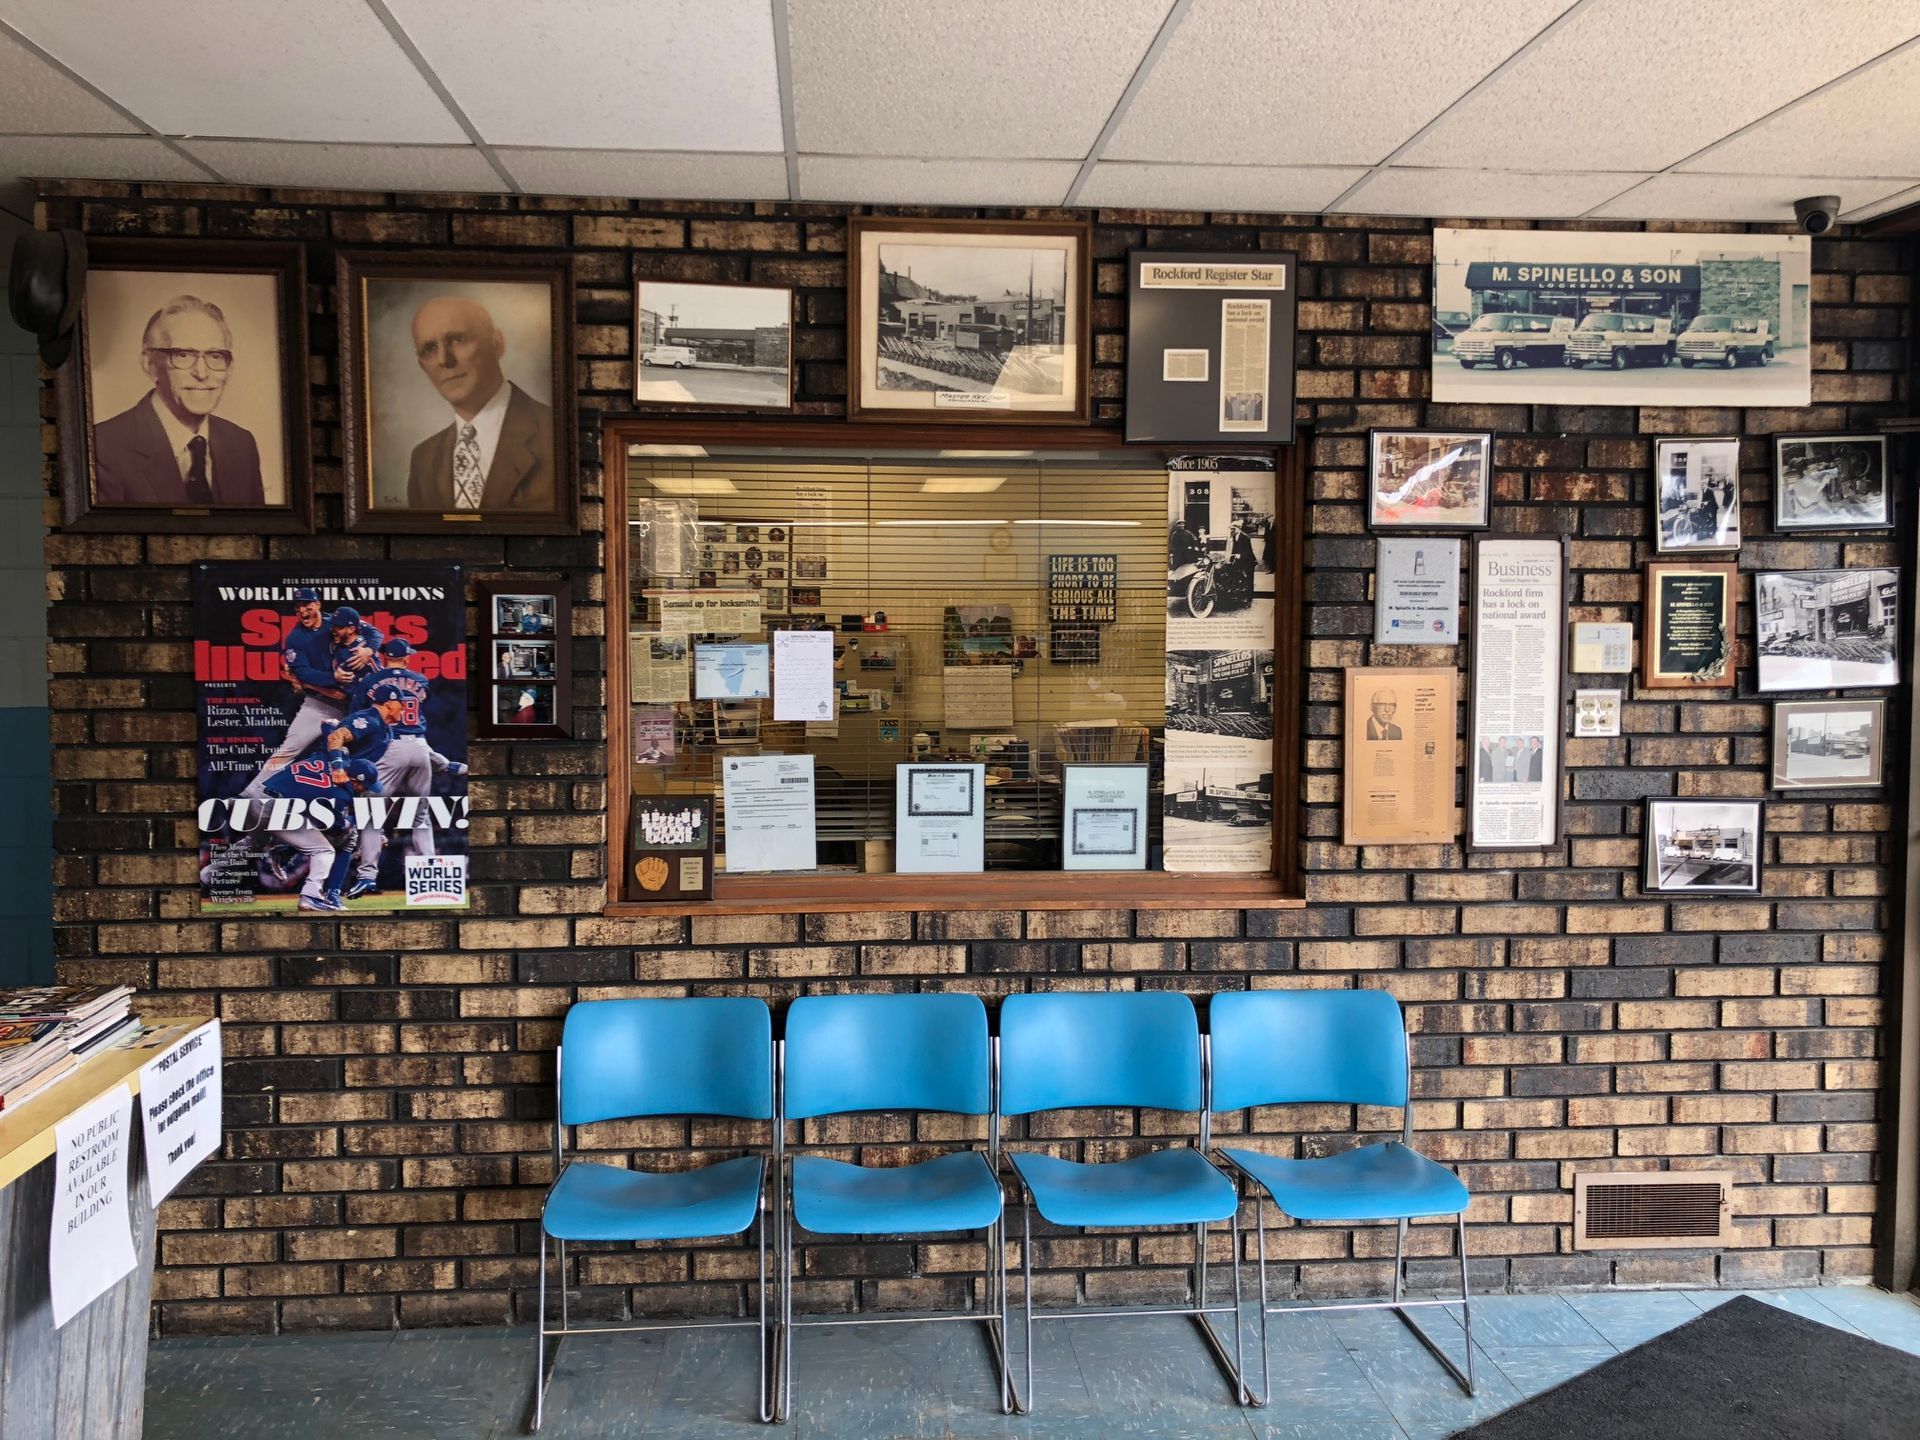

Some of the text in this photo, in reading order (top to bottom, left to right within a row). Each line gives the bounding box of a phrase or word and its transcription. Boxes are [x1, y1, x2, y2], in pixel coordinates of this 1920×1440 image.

[1152, 268, 1274, 283] Rockford Register Star
[1492, 267, 1681, 284] M. SPINELLO & SON
[1172, 458, 1218, 470] Since 1905
[1052, 557, 1114, 572] LIFE IS TOO
[1488, 561, 1552, 576] Business
[1052, 574, 1114, 588] SHORT TO BE
[311, 587, 445, 600] HAMPIONS
[1051, 590, 1114, 604] SERIOUS ALL
[1483, 588, 1543, 598] Rockford firm
[663, 600, 692, 608] Demand
[720, 600, 760, 608] locksmiths
[1483, 600, 1497, 608] has
[1507, 600, 1525, 608] lock
[1051, 607, 1114, 620] THE TIME
[1482, 610, 1546, 619] national award
[207, 745, 228, 755] The
[208, 761, 254, 771] All-Time
[198, 796, 469, 832] CUBS WIN!
[408, 867, 461, 879] WORLD
[409, 880, 462, 895] SERIES
[179, 1034, 202, 1059] SERVICE
[149, 1065, 214, 1122] Please check the office
[157, 1118, 166, 1135] for
[166, 1098, 191, 1126] outgoing
[71, 1109, 120, 1152] NO PUBLIC
[69, 1129, 119, 1174] RESTROOM
[168, 1131, 196, 1166] Thank you!
[66, 1148, 118, 1196] AVAILABLE
[75, 1175, 107, 1208] IN OUR
[67, 1190, 113, 1234] BUILDING
